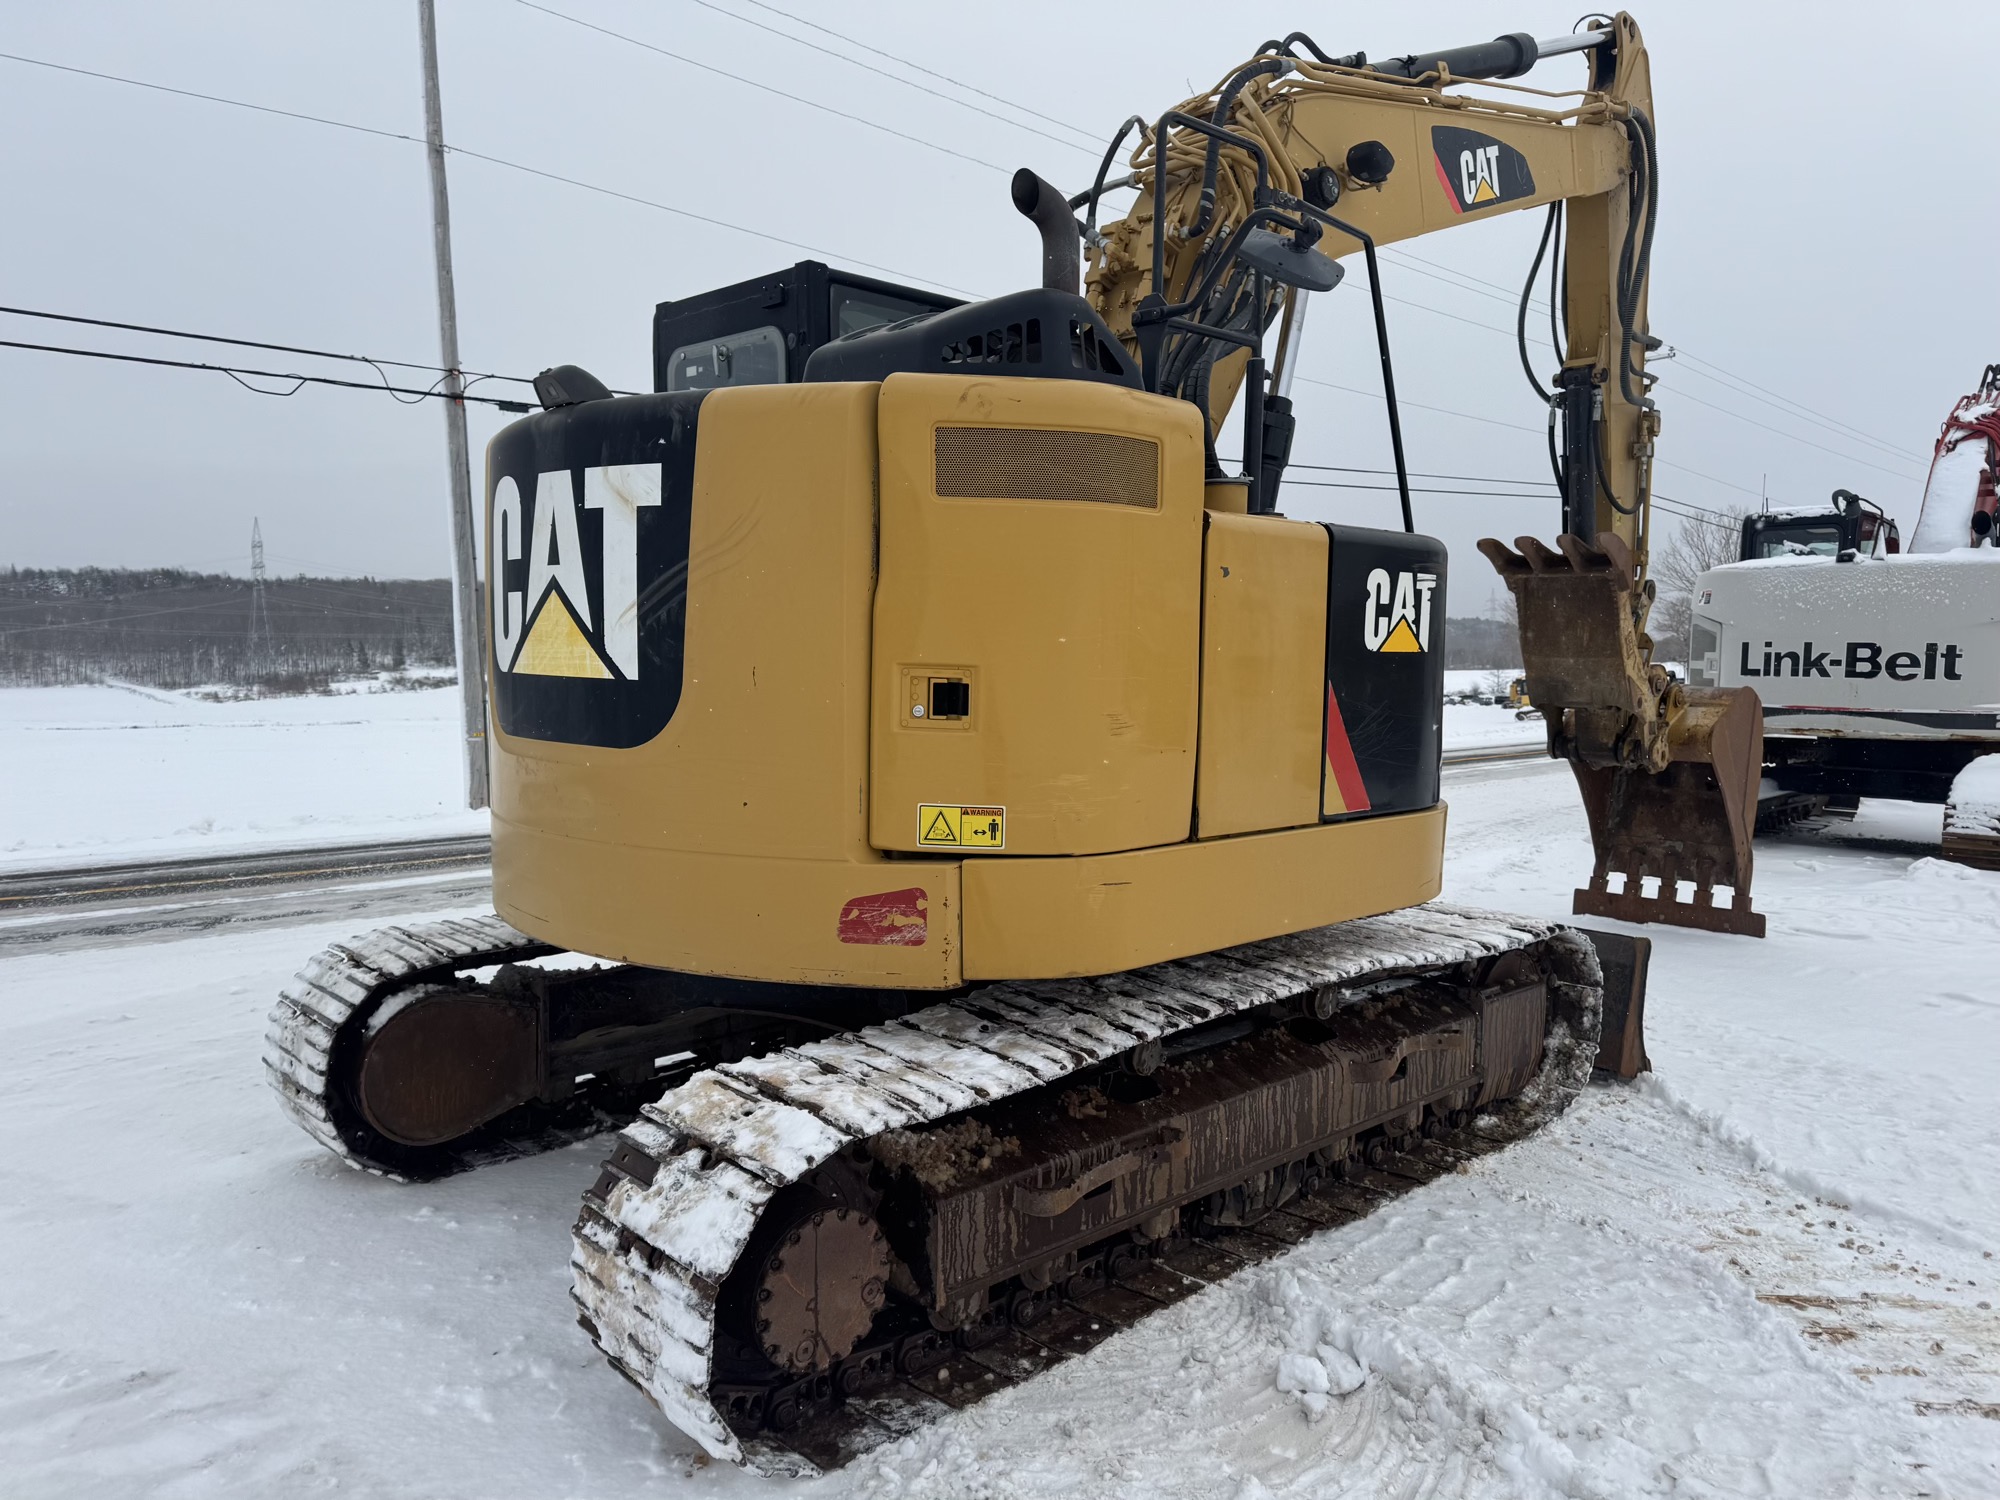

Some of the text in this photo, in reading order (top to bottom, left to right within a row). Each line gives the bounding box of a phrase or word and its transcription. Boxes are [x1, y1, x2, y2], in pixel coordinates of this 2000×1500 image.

[1460, 145, 1500, 204] CAT
[493, 463, 662, 680] CAT
[1364, 568, 1437, 653] CAT
[1740, 641, 1963, 681] Link-Belt
